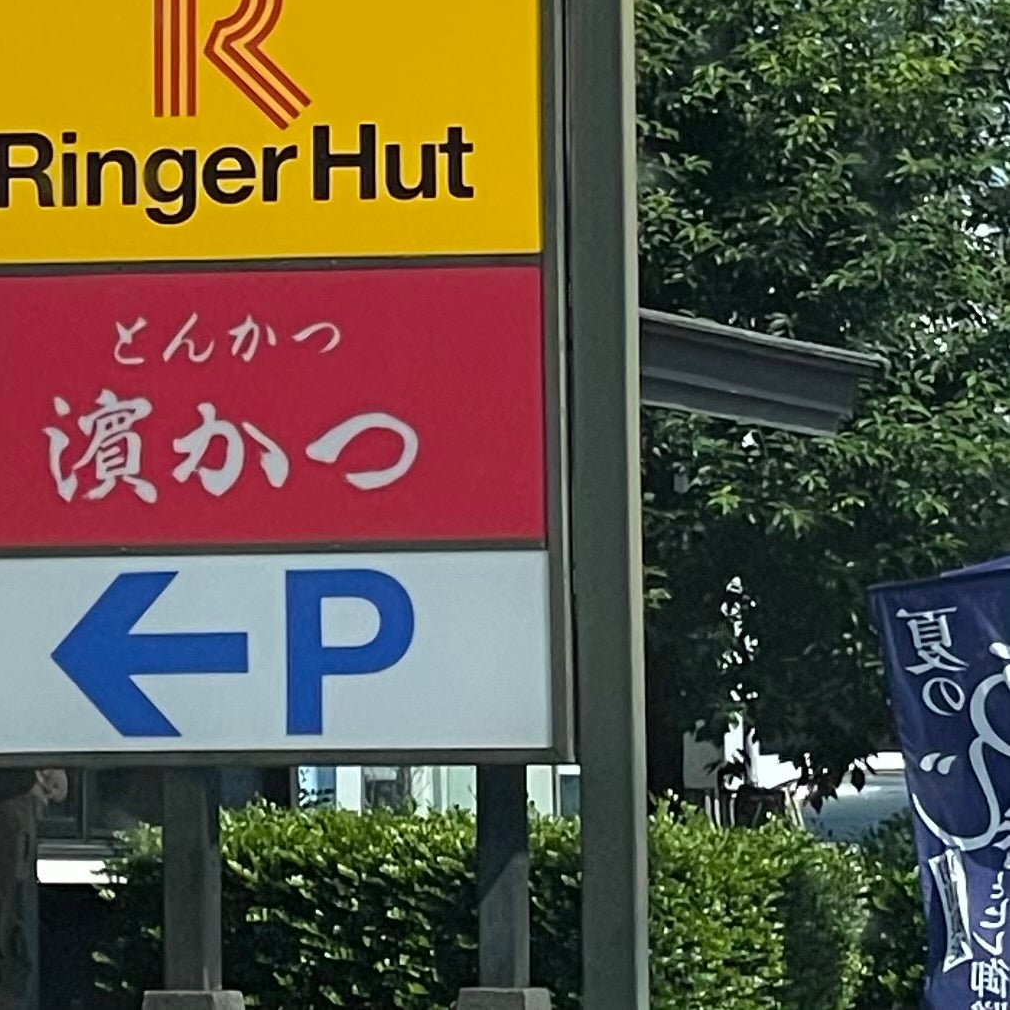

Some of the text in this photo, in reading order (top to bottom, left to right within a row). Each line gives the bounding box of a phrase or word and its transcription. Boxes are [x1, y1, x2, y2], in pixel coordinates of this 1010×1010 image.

[312, 123, 474, 201] Hut
[113, 312, 342, 365] とんかつ
[43, 388, 419, 504] 濱かつ
[285, 568, 416, 736] P
